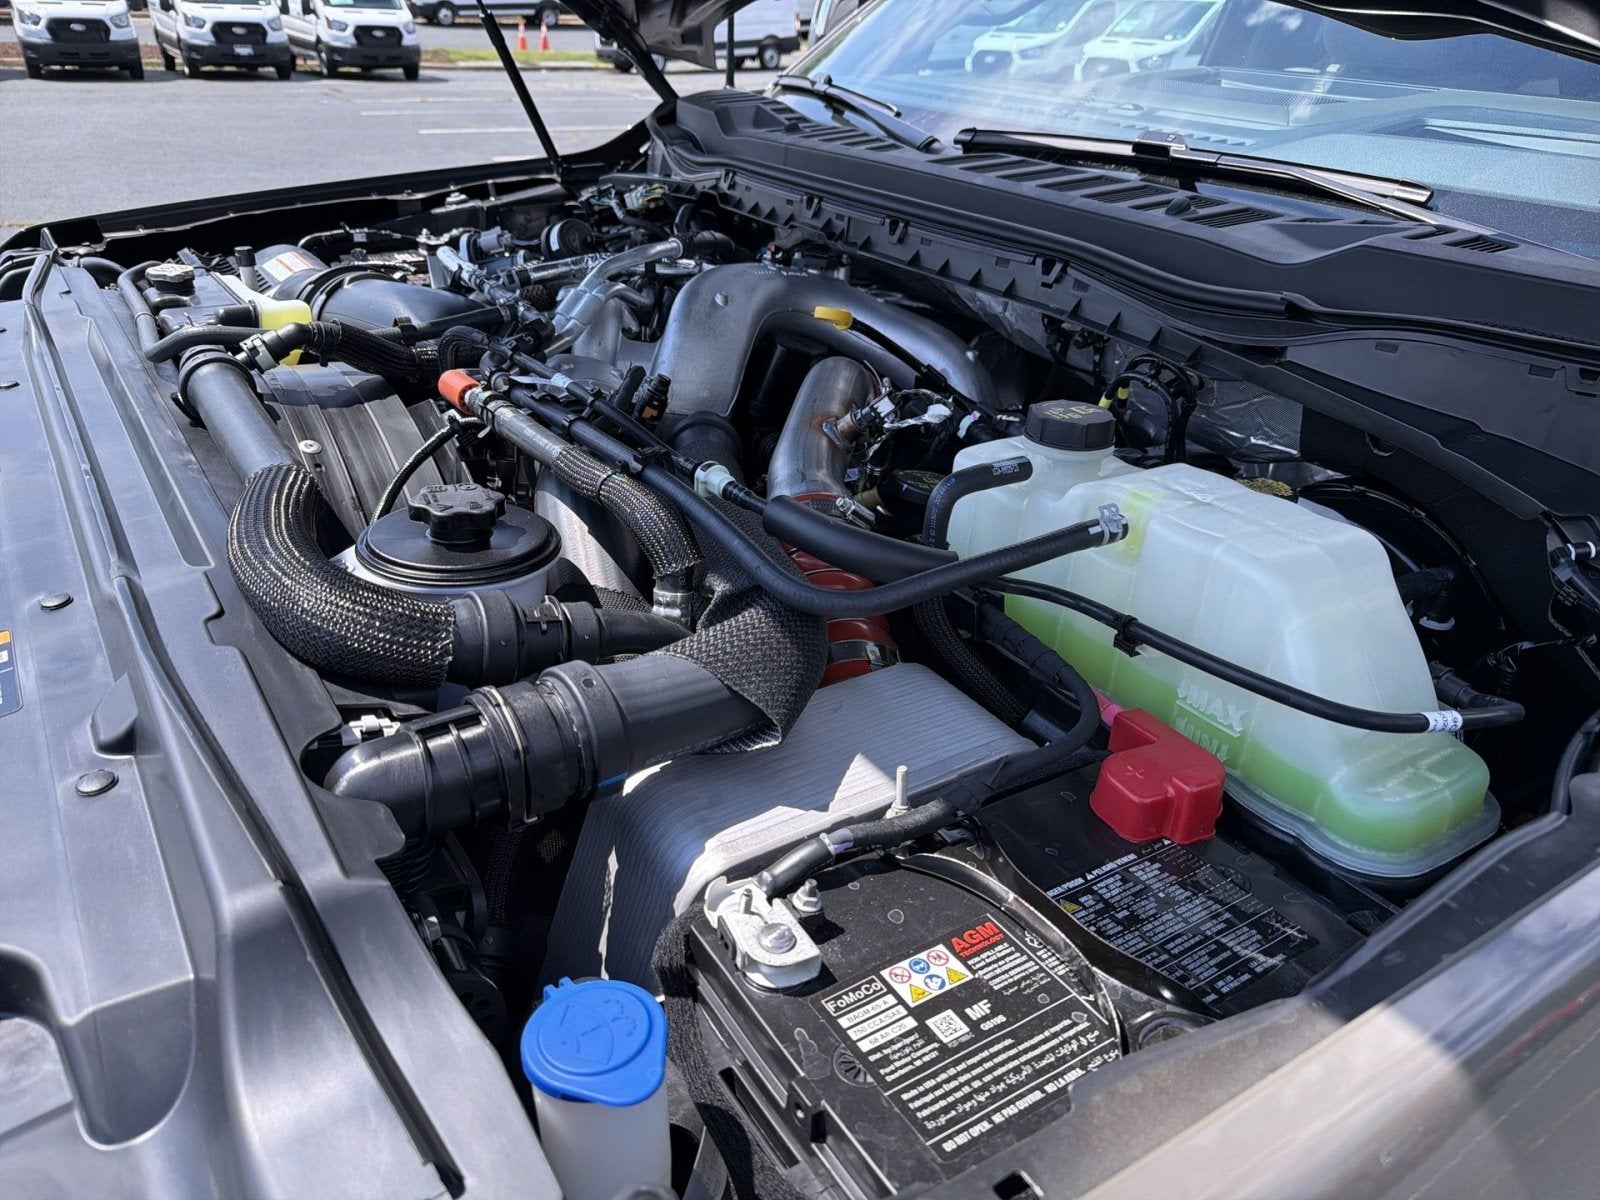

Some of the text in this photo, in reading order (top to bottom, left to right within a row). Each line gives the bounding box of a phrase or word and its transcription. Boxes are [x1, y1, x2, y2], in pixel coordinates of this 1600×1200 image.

[1187, 683, 1247, 732] MAX
[952, 922, 999, 952] AGM
[959, 933, 1003, 957] TECHNOLOGY
[827, 982, 881, 1011] FoMoCo
[964, 999, 991, 1020] MF
[846, 1000, 888, 1022] BAGM-65-A
[852, 1008, 902, 1036] 750 CCA/SAE
[890, 1023, 907, 1033] C20
[879, 1064, 895, 1075] Ford
[942, 1139, 957, 1151] DO
[953, 1131, 971, 1145] NOT
[968, 1120, 993, 1137] OPEN.
[991, 1112, 1005, 1123] NE
[1001, 1104, 1018, 1117] PAS
[1044, 1082, 1057, 1093] NO
[1053, 1078, 1067, 1087] LA
